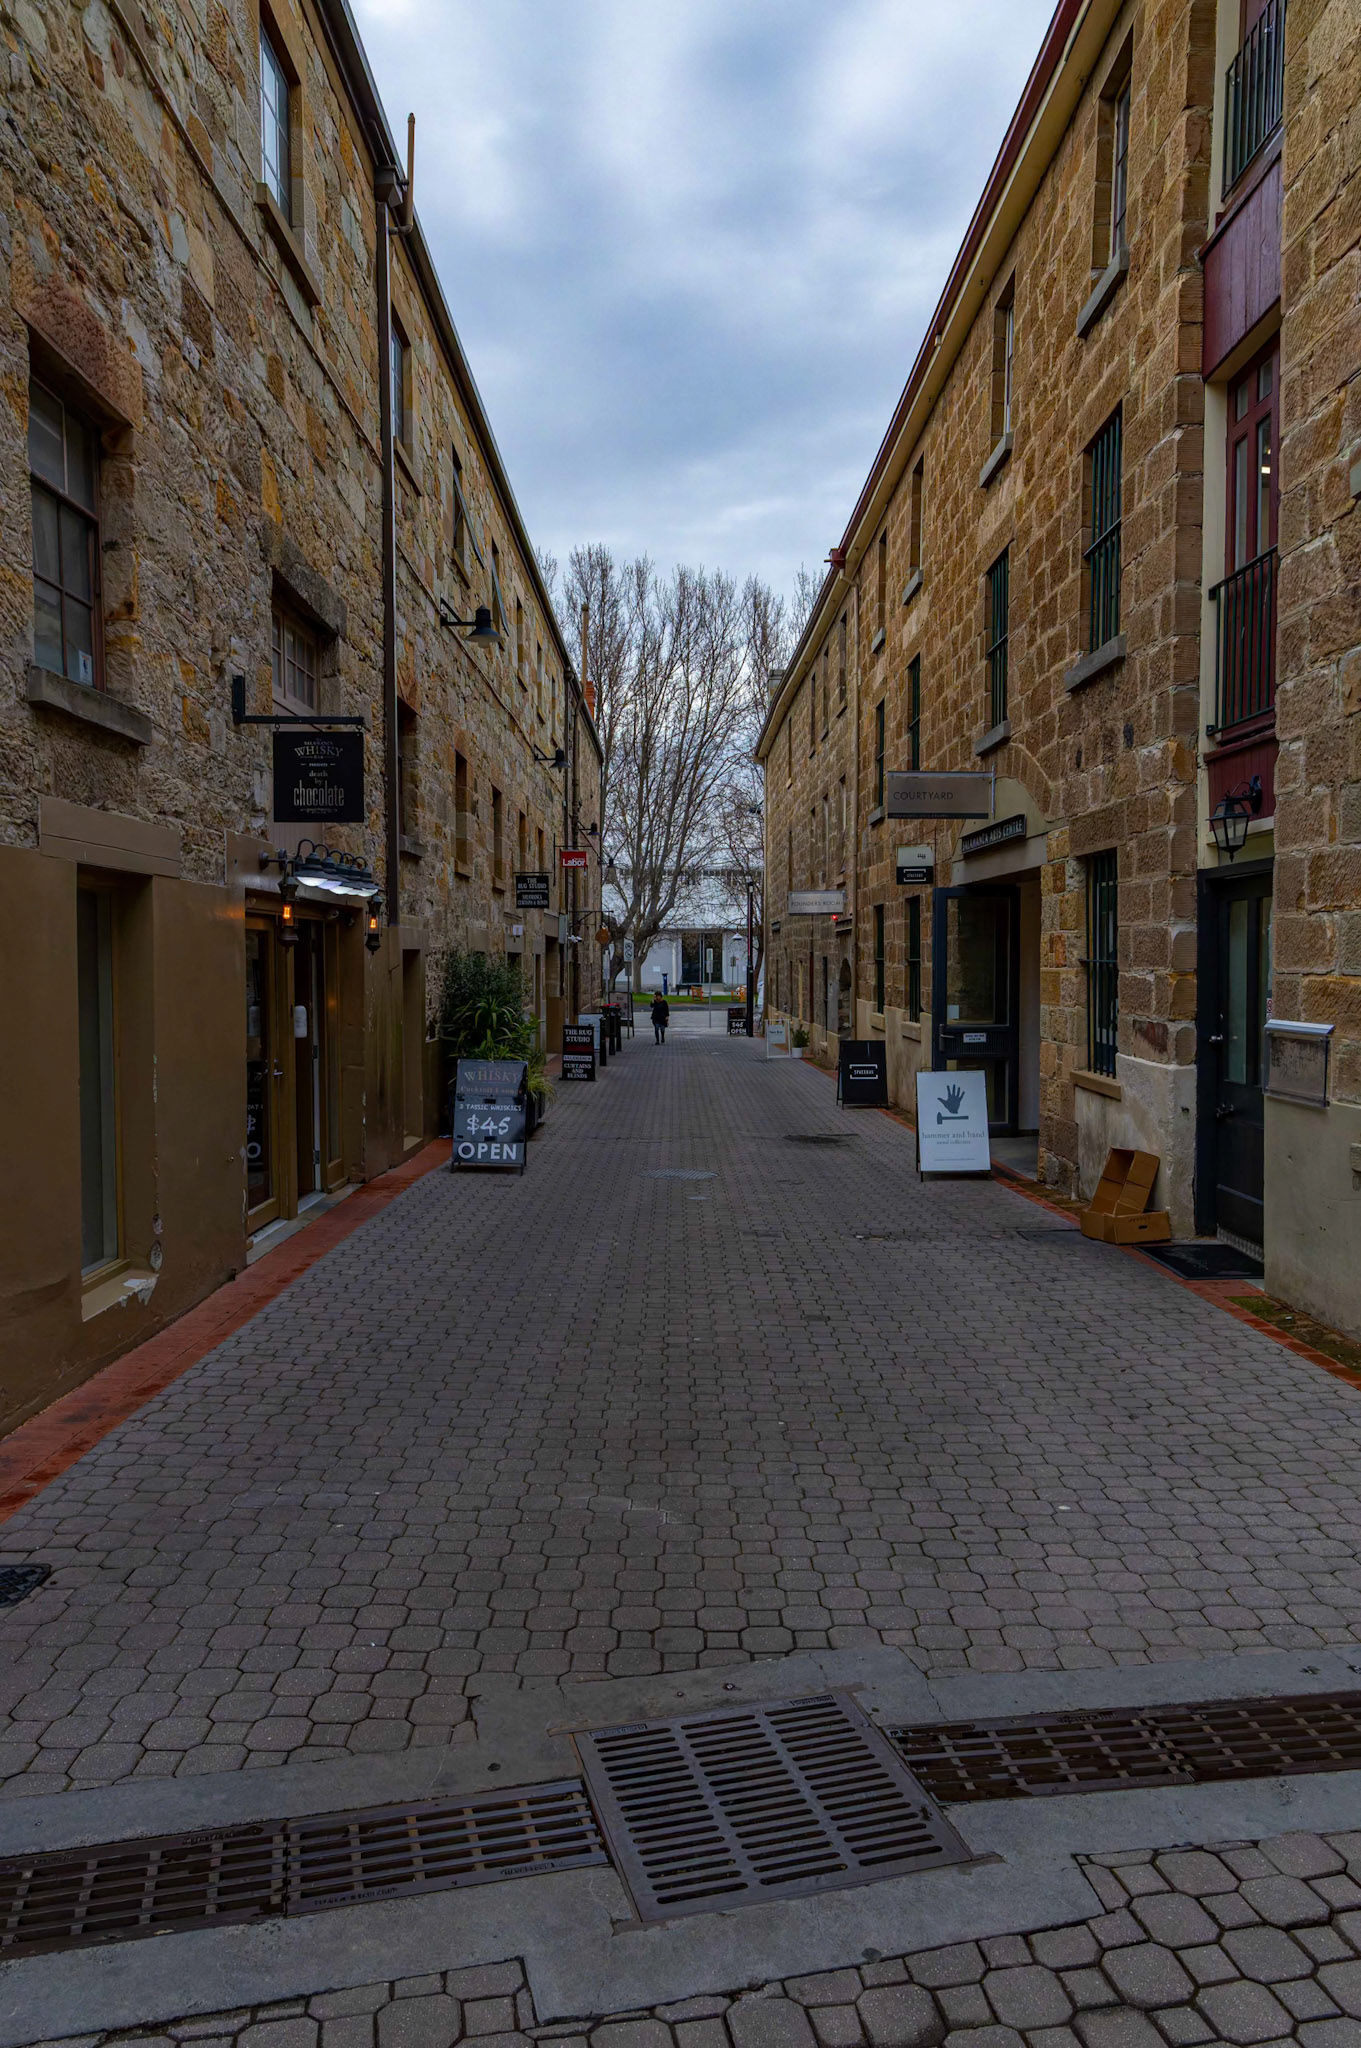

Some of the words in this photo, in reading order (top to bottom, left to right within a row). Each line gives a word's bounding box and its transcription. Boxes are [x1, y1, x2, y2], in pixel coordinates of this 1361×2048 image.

[293, 745, 343, 757] WHISKY
[293, 778, 345, 807] chocolate
[893, 791, 954, 801] COURTYARD
[563, 858, 585, 866] Labor
[464, 1070, 518, 1083] WHISKY
[466, 1113, 512, 1136] $45
[922, 1131, 950, 1139] hammer
[952, 1130, 965, 1138] and
[967, 1130, 985, 1138] hand
[457, 1141, 518, 1160] OPEN
